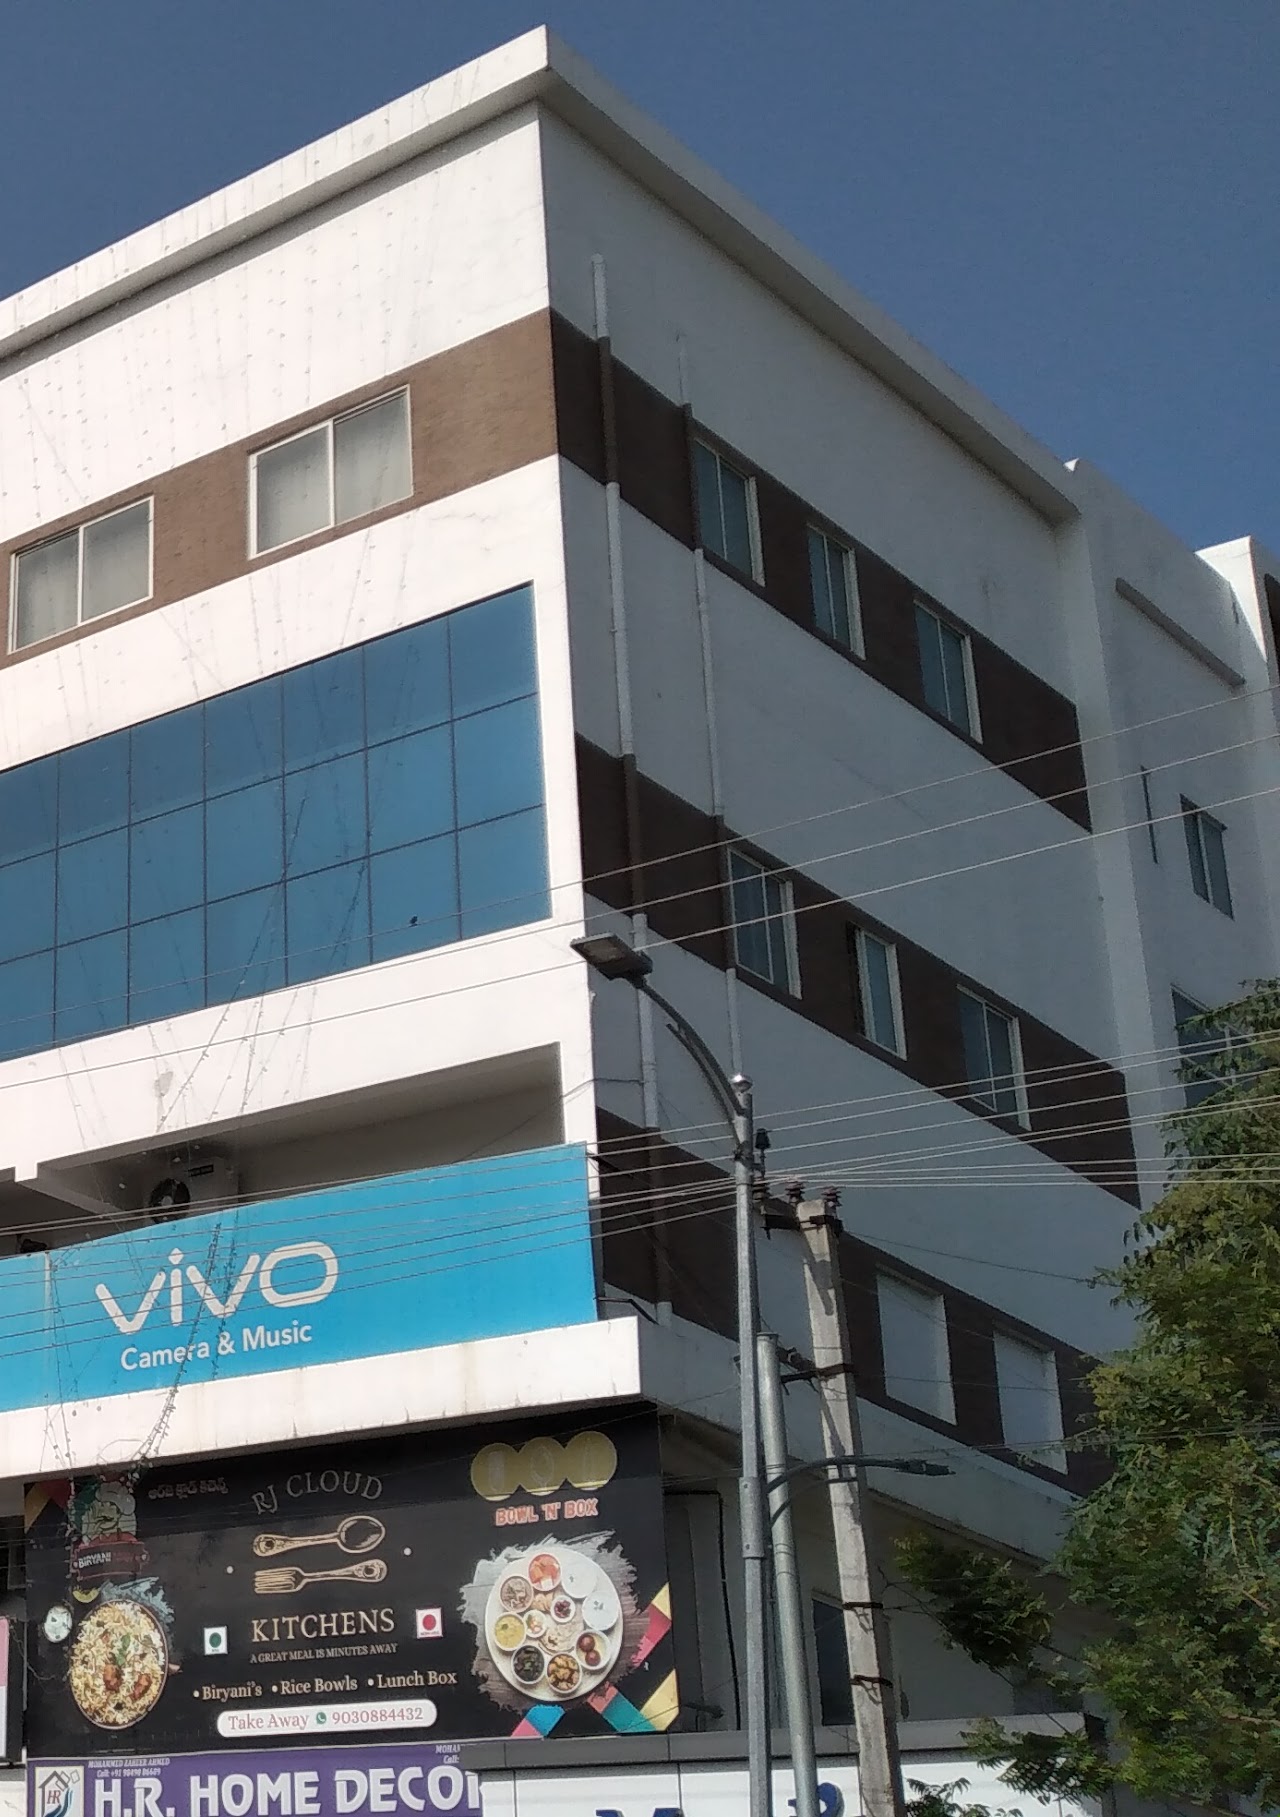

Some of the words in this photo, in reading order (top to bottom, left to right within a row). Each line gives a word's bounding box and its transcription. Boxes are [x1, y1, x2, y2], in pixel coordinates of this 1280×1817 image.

[95, 1241, 339, 1335] vivo
[120, 1340, 210, 1371] Camera
[217, 1331, 236, 1356] &
[242, 1319, 313, 1352] Music
[251, 1484, 278, 1515] RJ
[286, 1470, 383, 1500] CLOUD
[495, 1505, 539, 1527] BOWL
[564, 1498, 599, 1519] BOX
[251, 1608, 396, 1643] KITCHENS
[258, 1651, 288, 1663] GREAT
[289, 1649, 315, 1660] MEAL
[316, 1648, 325, 1659] IS
[326, 1645, 368, 1658] MINUTES
[369, 1643, 398, 1655] AWAY
[280, 1679, 311, 1696] Rice
[314, 1675, 358, 1693] Bowls
[378, 1670, 425, 1689] Lunch
[428, 1670, 457, 1685] Box
[228, 1714, 264, 1731] Take
[267, 1712, 309, 1731] Away
[332, 1707, 423, 1725] 9030884432
[95, 1778, 175, 1817] H.R.
[190, 1771, 321, 1817] HOME
